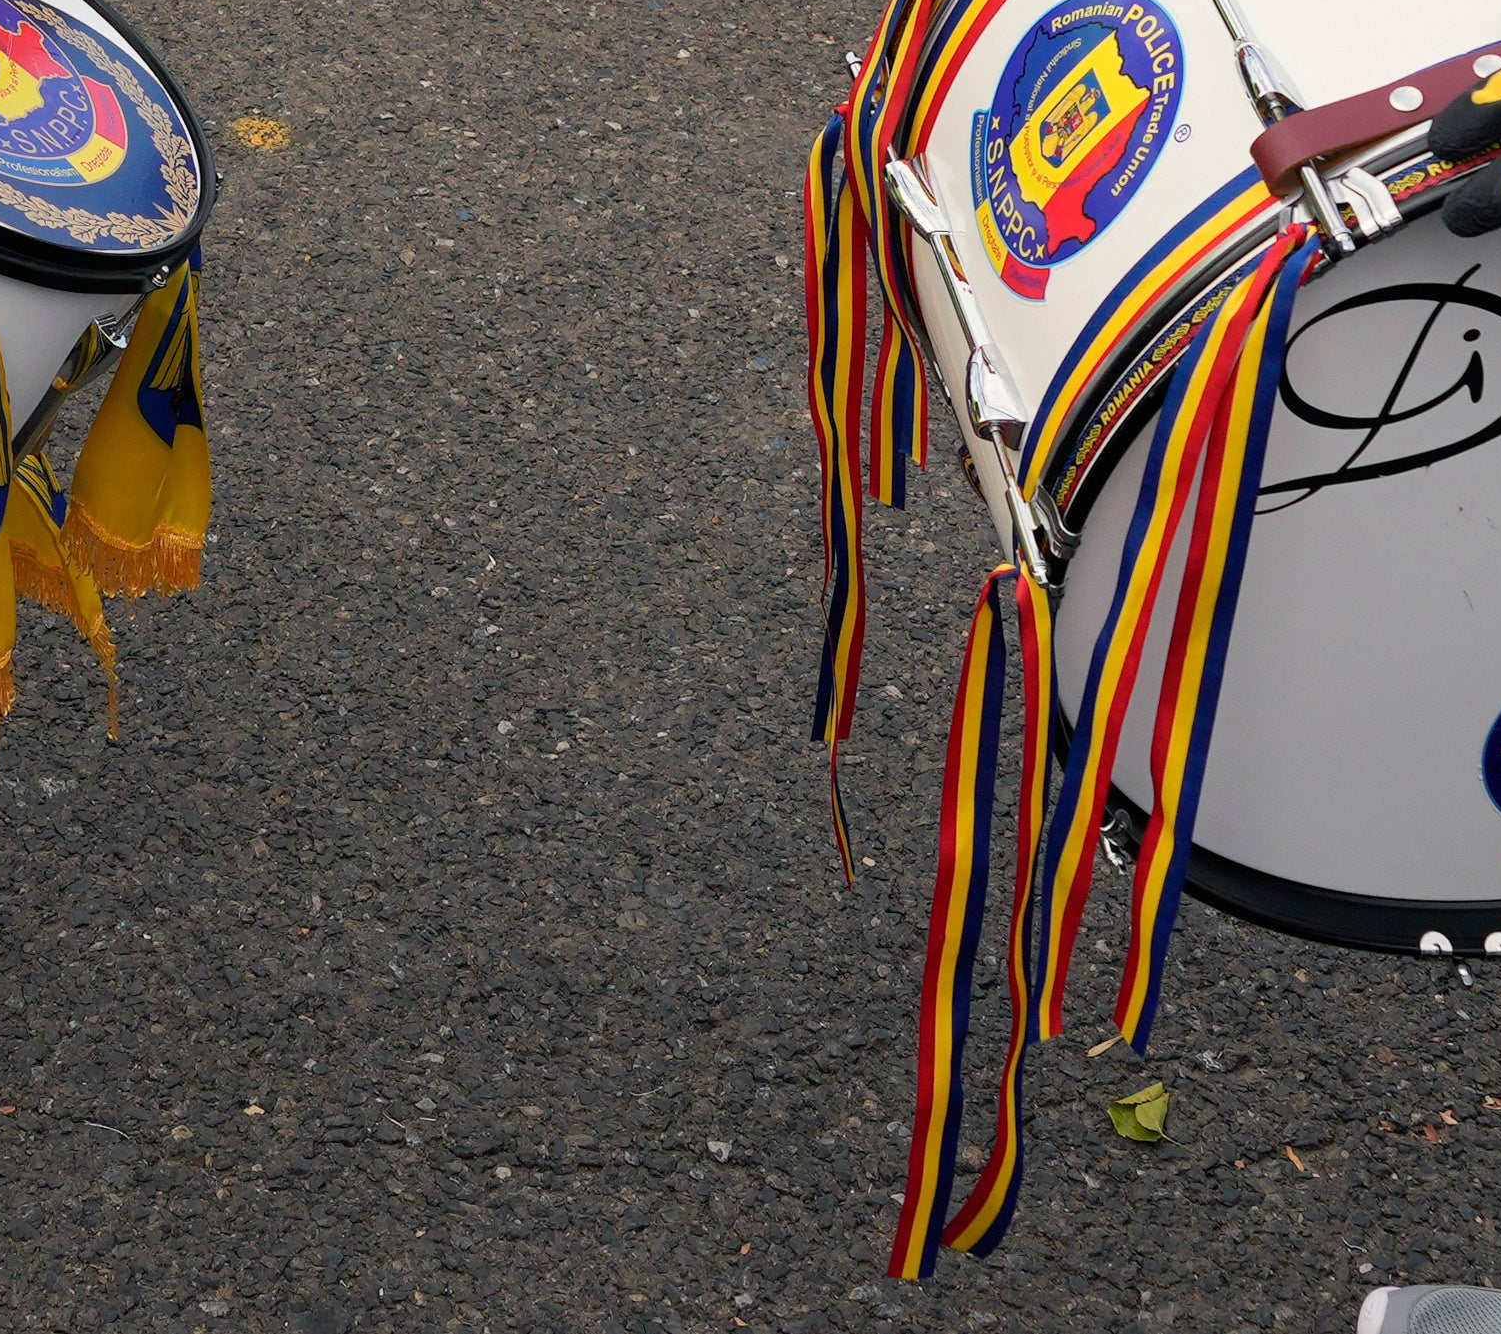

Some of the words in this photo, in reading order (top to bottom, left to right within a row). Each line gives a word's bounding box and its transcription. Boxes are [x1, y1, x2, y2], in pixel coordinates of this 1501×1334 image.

[1051, 1, 1125, 33] Romanian
[1121, 3, 1176, 96] POLICE
[1148, 93, 1171, 135] Trade
[1110, 133, 1153, 199] Union
[1100, 361, 1155, 428] ROMANIA
